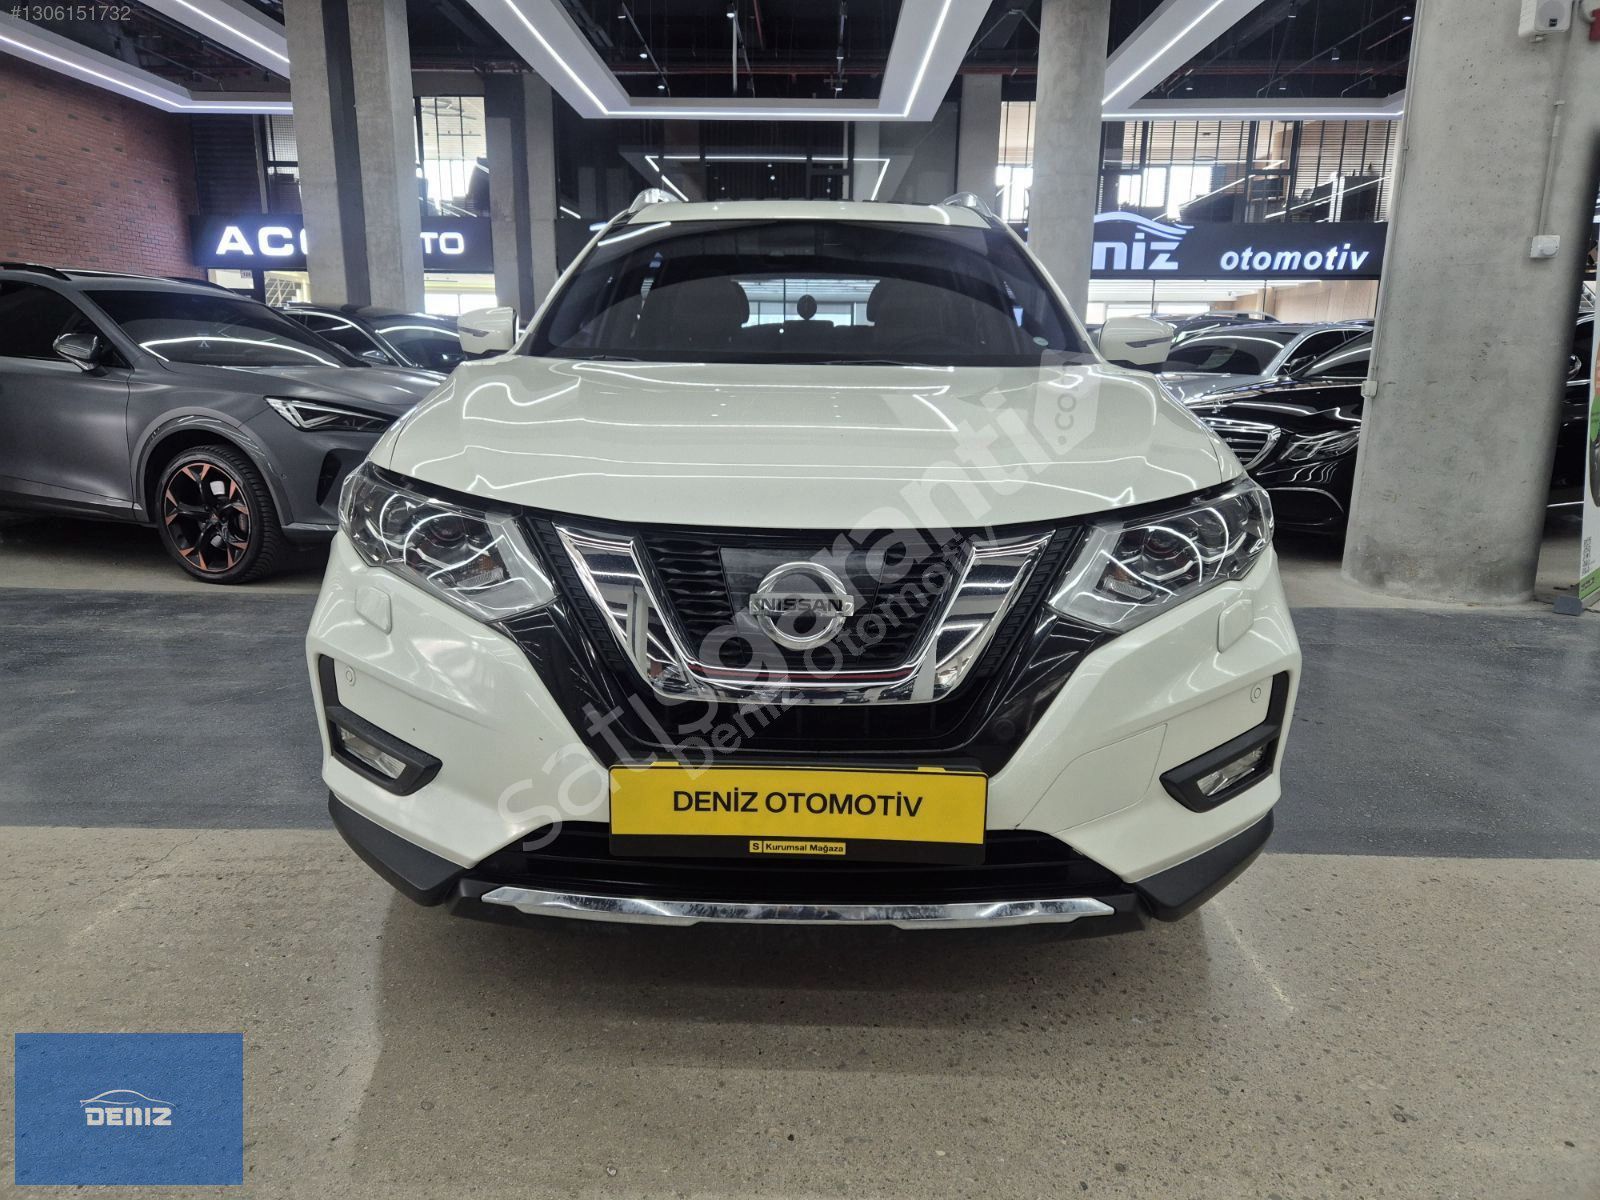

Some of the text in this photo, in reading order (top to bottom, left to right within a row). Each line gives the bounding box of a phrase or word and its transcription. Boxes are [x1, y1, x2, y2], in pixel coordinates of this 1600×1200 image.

[216, 225, 465, 256] AC TO
[1091, 232, 1370, 271] niz otomotiv
[761, 597, 844, 612] NISSAN
[673, 786, 924, 818] DENİZ OTOMOTİV
[752, 842, 844, 854] S Kurumsal Mağaza
